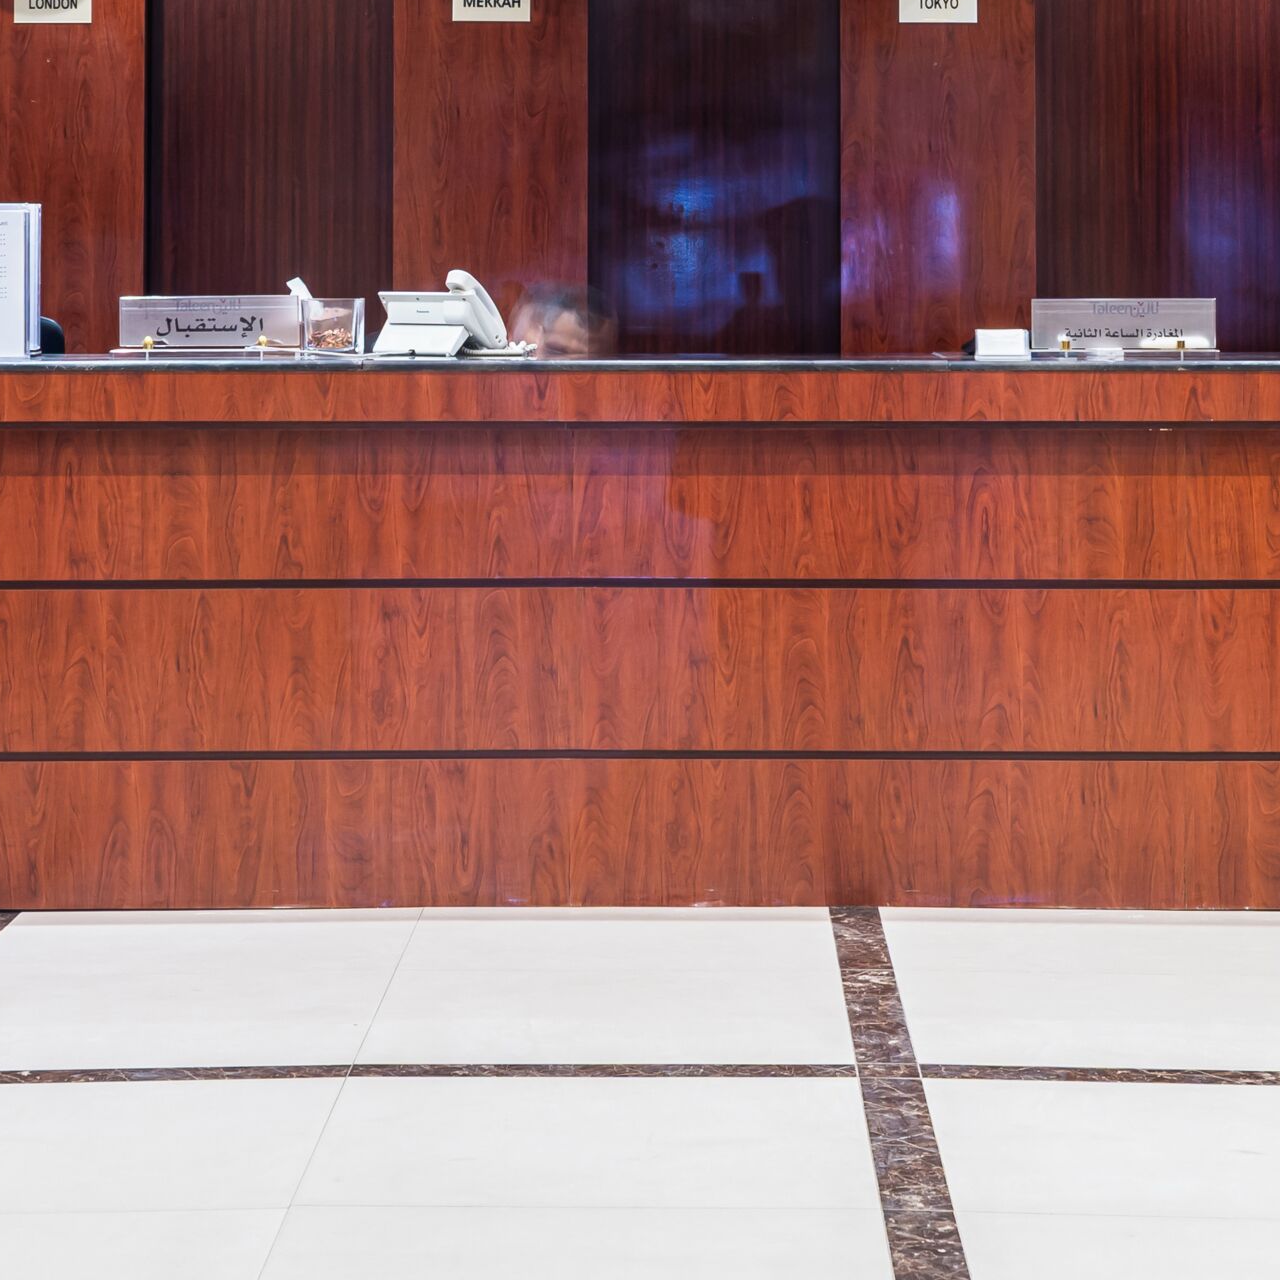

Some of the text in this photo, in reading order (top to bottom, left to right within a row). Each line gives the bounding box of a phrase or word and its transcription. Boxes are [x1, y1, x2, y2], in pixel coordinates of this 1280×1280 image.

[1090, 301, 1132, 314] Taleen
[156, 315, 264, 338] الإستقبال
[1065, 328, 1184, 341] المغادرة الساعة الثانية
